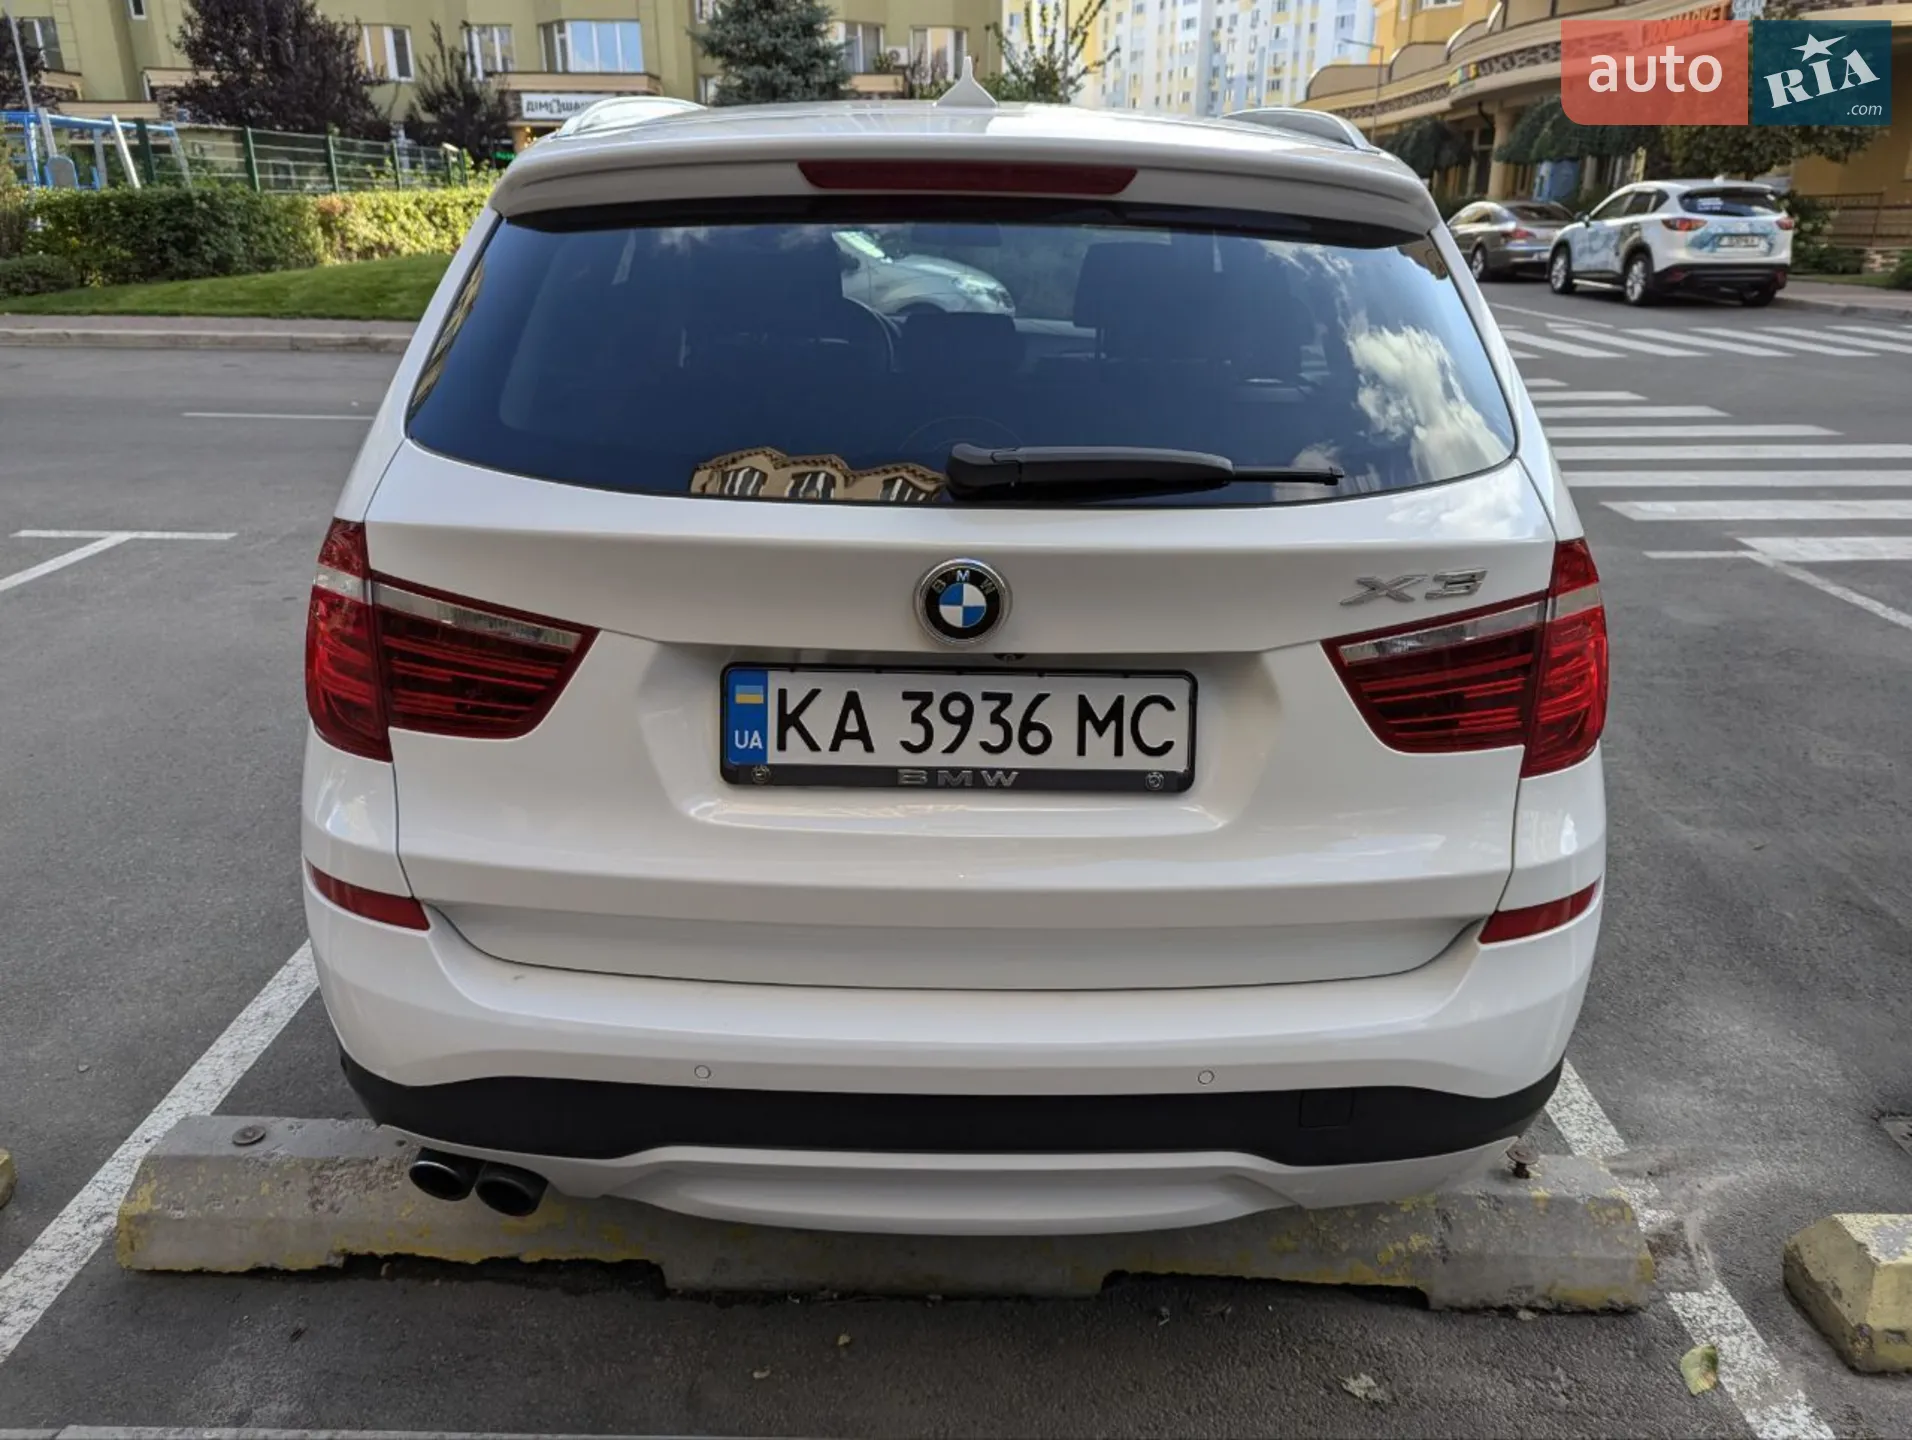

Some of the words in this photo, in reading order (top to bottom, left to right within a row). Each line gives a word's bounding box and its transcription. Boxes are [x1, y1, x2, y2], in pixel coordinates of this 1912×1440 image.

[931, 569, 996, 596] BMW
[1339, 567, 1488, 606] X3
[776, 687, 875, 753] KA
[899, 690, 1053, 756] 3936
[1076, 693, 1176, 758] MC
[734, 730, 763, 750] UA
[896, 768, 1020, 788] BMW
